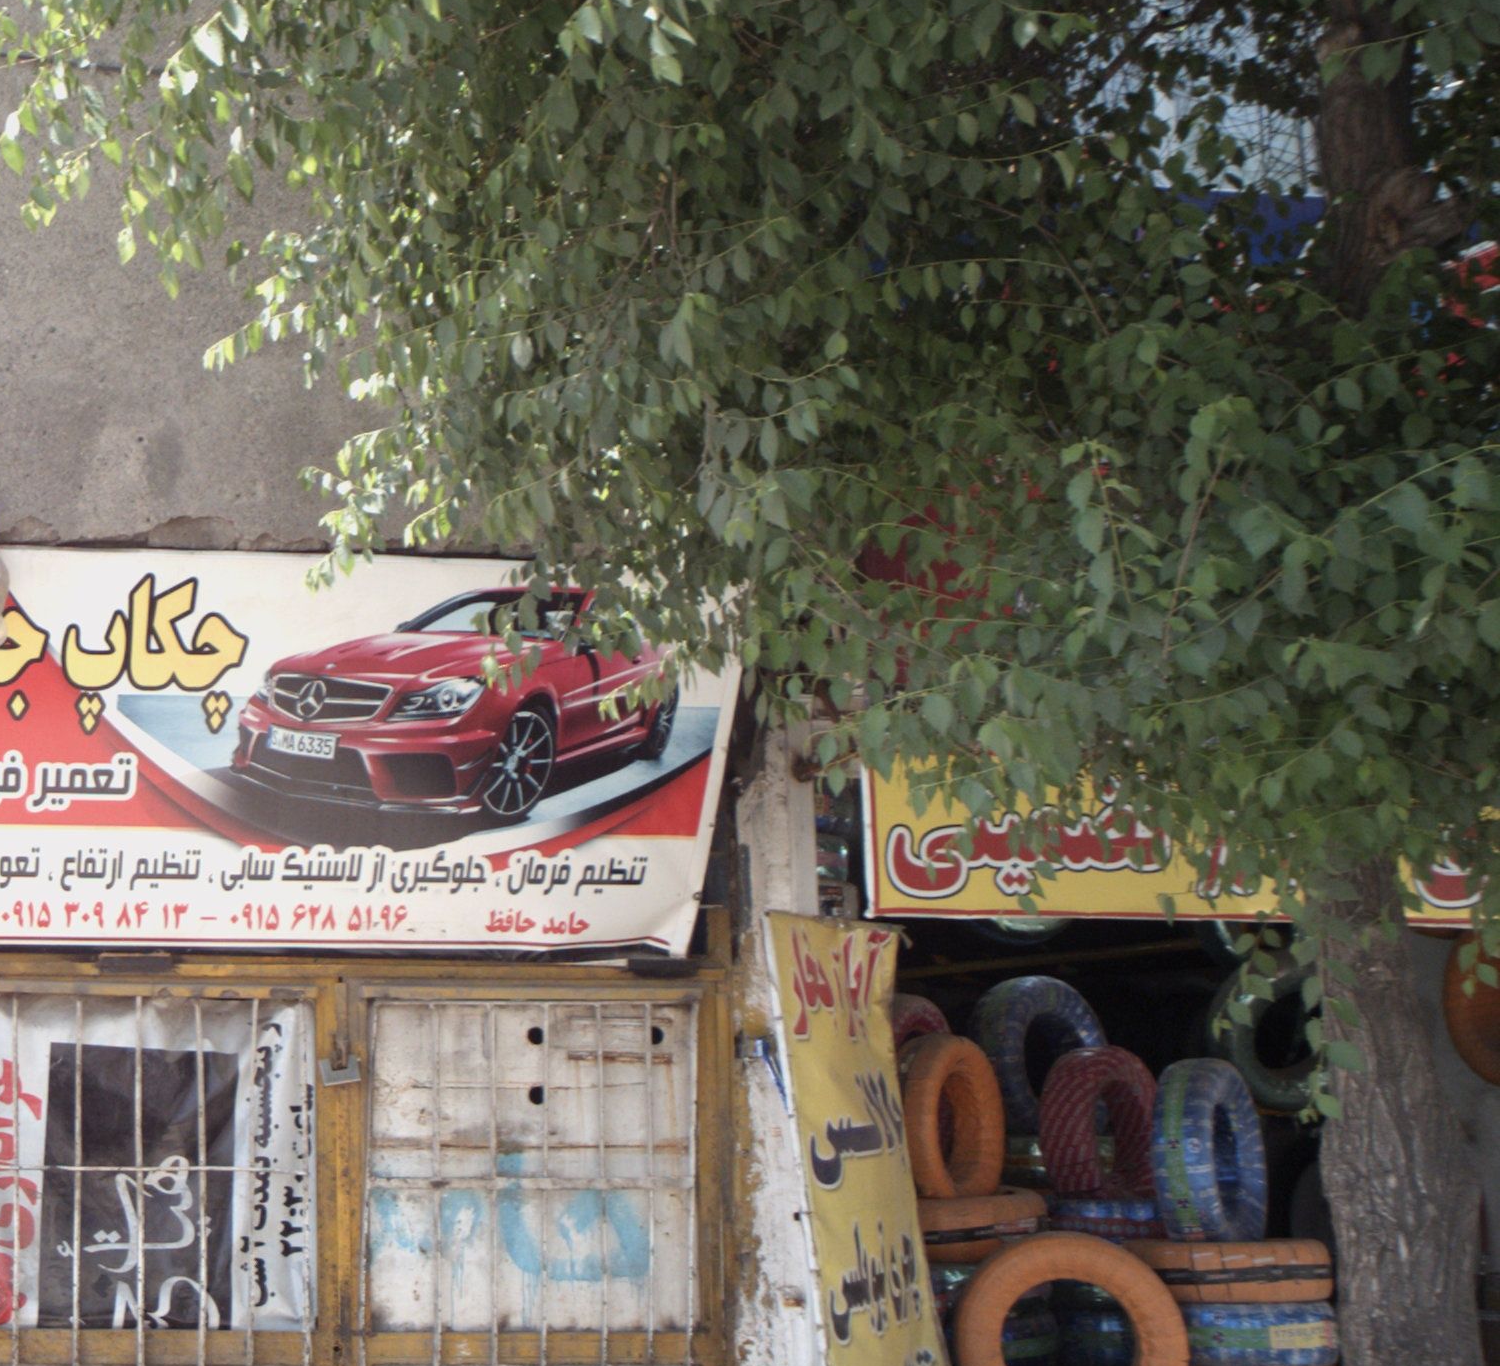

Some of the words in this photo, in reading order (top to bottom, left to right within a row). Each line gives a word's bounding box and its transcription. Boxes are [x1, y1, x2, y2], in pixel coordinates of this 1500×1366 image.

[61, 572, 250, 734] چکاپ
[297, 735, 333, 755] 6335
[34, 756, 134, 809] تعمیر
[130, 849, 201, 892] تنظیم
[282, 849, 362, 889] لاستیک
[367, 849, 384, 894] از
[390, 848, 487, 894] جلوگیری
[575, 857, 649, 896] تنظیم
[1, 900, 51, 928] ۰۹۱۵
[64, 901, 104, 928] ۳۰۹
[116, 901, 149, 929] ۸۴
[162, 903, 190, 930] ۱۳
[230, 904, 280, 930] ۰۹۱۵
[291, 903, 336, 930] ۶۲۸
[485, 908, 537, 934] حافظ
[542, 910, 591, 935] حامد
